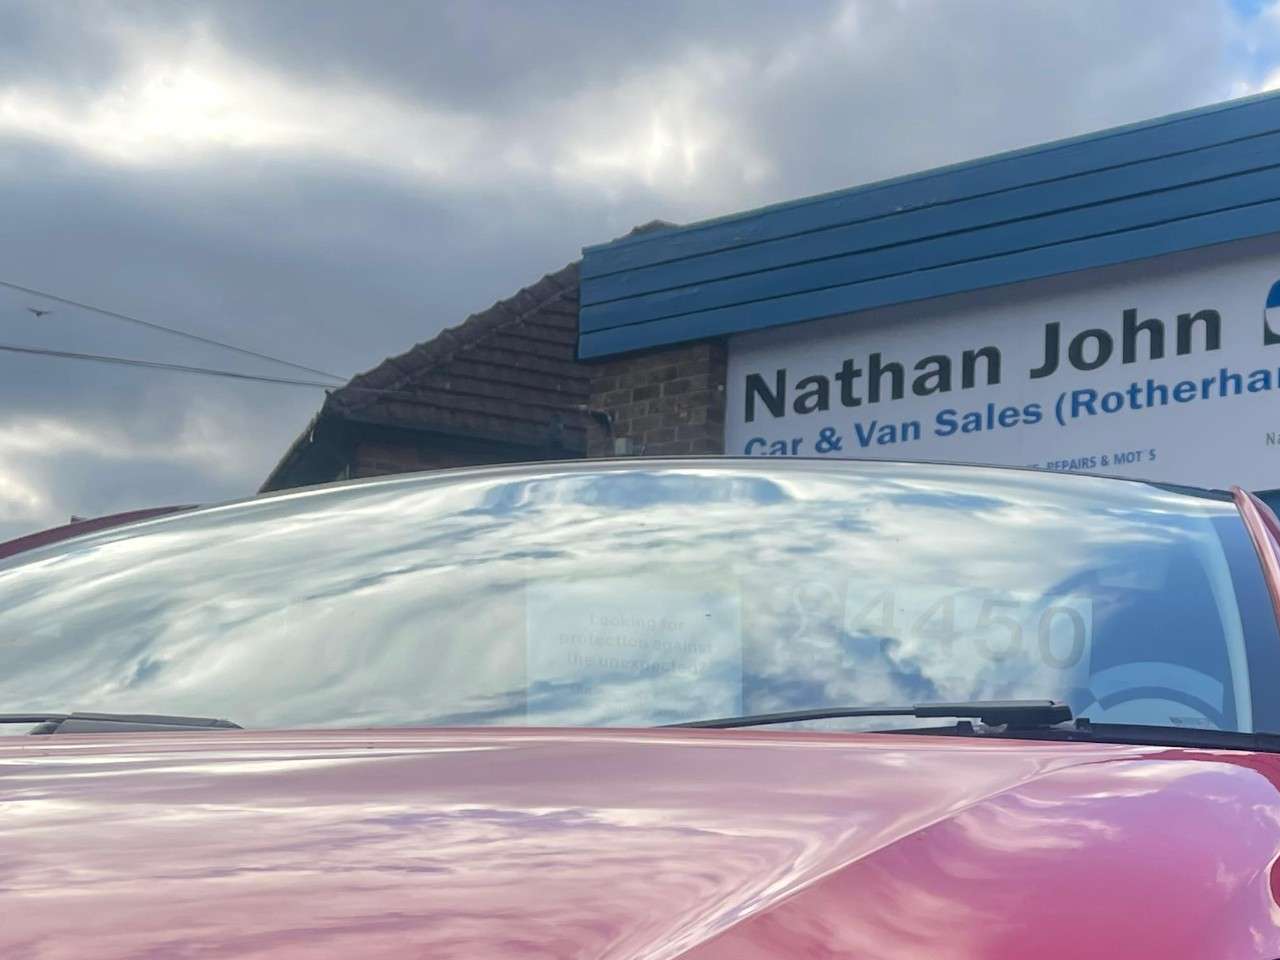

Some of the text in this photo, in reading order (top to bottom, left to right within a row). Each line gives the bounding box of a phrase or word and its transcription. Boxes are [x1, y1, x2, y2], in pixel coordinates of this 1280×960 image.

[744, 307, 1222, 423] Nathan John
[815, 426, 843, 454] &
[854, 419, 921, 448] Van
[934, 403, 1042, 437] Sales
[1047, 455, 1097, 471] REPAIRS
[1100, 454, 1110, 467] &
